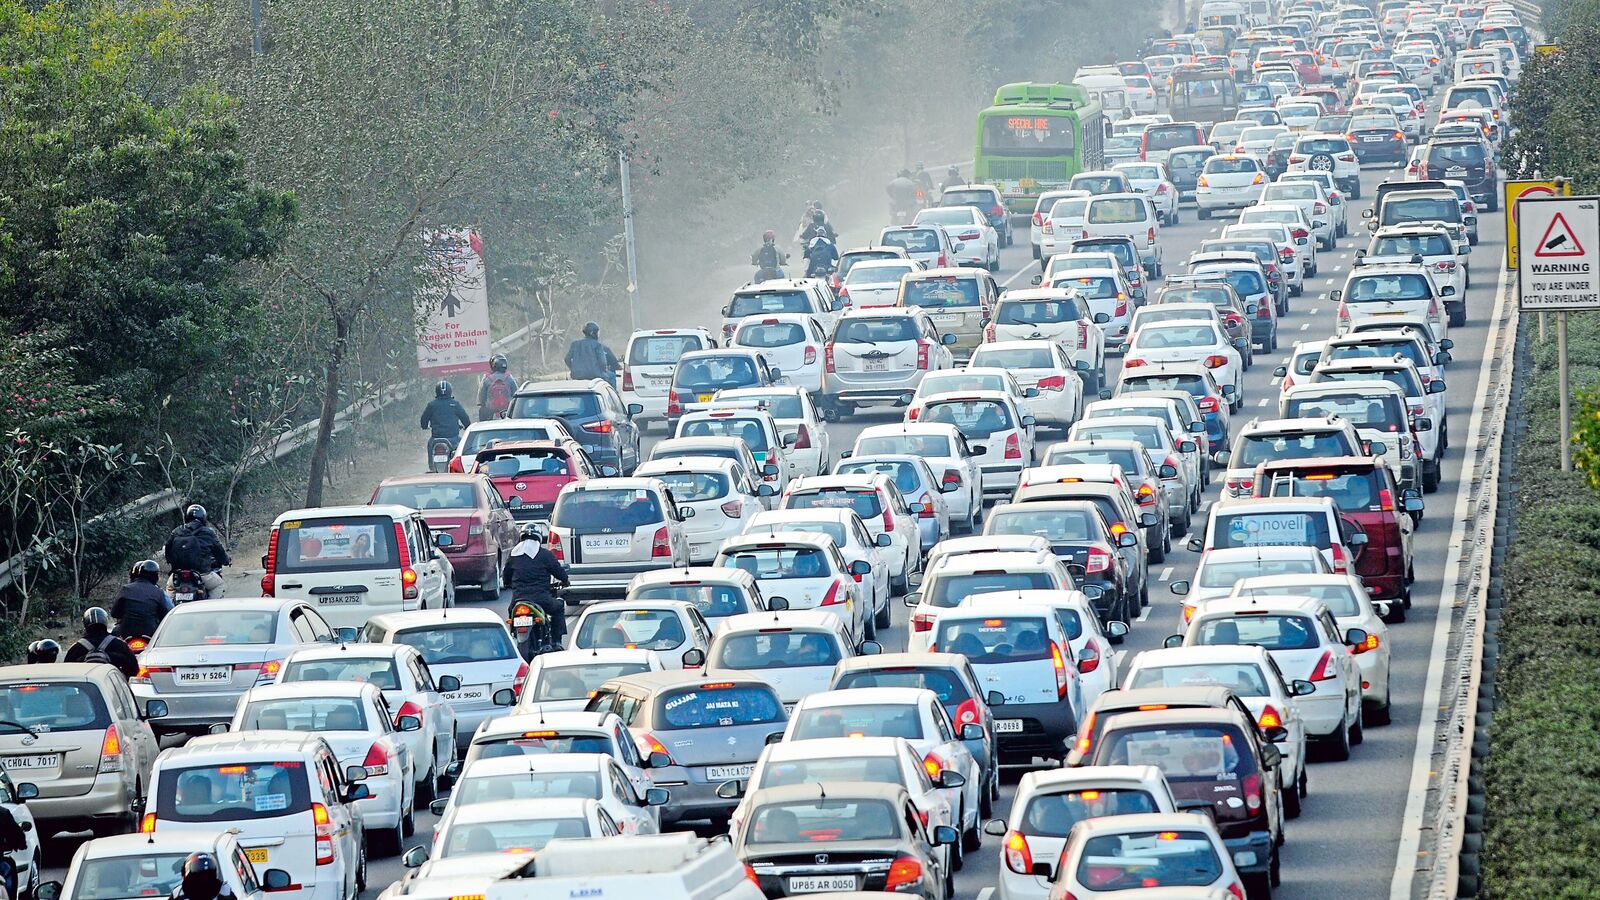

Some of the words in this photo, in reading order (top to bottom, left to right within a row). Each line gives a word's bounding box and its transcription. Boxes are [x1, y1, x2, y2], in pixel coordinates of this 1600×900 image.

[1008, 118, 1032, 129] SPECIAL
[1035, 118, 1048, 129] HIRE
[1531, 263, 1590, 272] WARNING
[1532, 282, 1546, 291] YOU
[1549, 282, 1563, 290] ARE
[1565, 281, 1590, 290] UNDER
[1524, 295, 1542, 303] CCTV
[1545, 294, 1598, 303] SURVEILLANCE
[444, 322, 460, 330] For
[454, 330, 488, 338] Maidan
[454, 338, 477, 347] Delhi
[1263, 515, 1303, 530] novell
[345, 593, 360, 603] 2752
[202, 672, 208, 680] Y
[209, 671, 227, 679] 5264
[665, 692, 698, 710] GUJJAR
[7, 758, 32, 767] CH04L
[37, 756, 57, 766] 7017
[792, 881, 814, 890] UP85
[817, 881, 830, 889] AR
[832, 880, 854, 889] 0050
